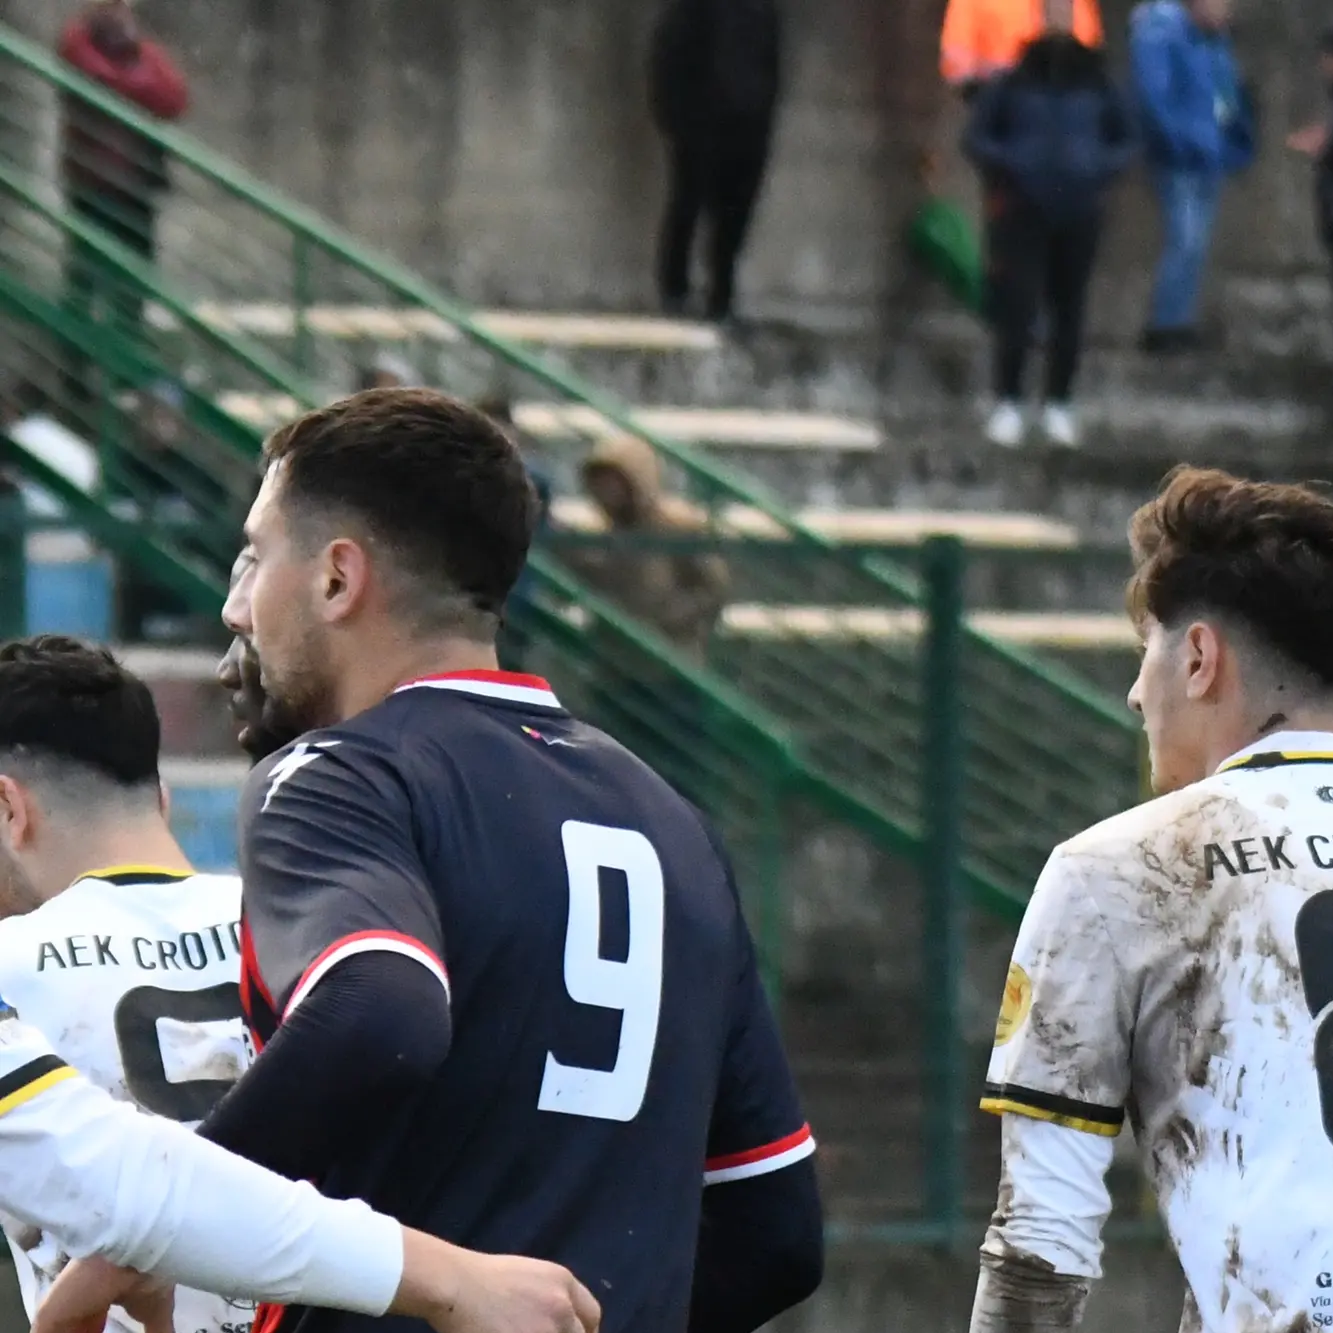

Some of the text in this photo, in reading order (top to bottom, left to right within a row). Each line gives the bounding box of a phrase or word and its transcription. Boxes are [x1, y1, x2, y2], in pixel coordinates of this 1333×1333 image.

[1203, 834, 1297, 881] AEK
[37, 935, 120, 972] AEK
[538, 819, 664, 1122] 9
[1310, 1296, 1331, 1308] Via
